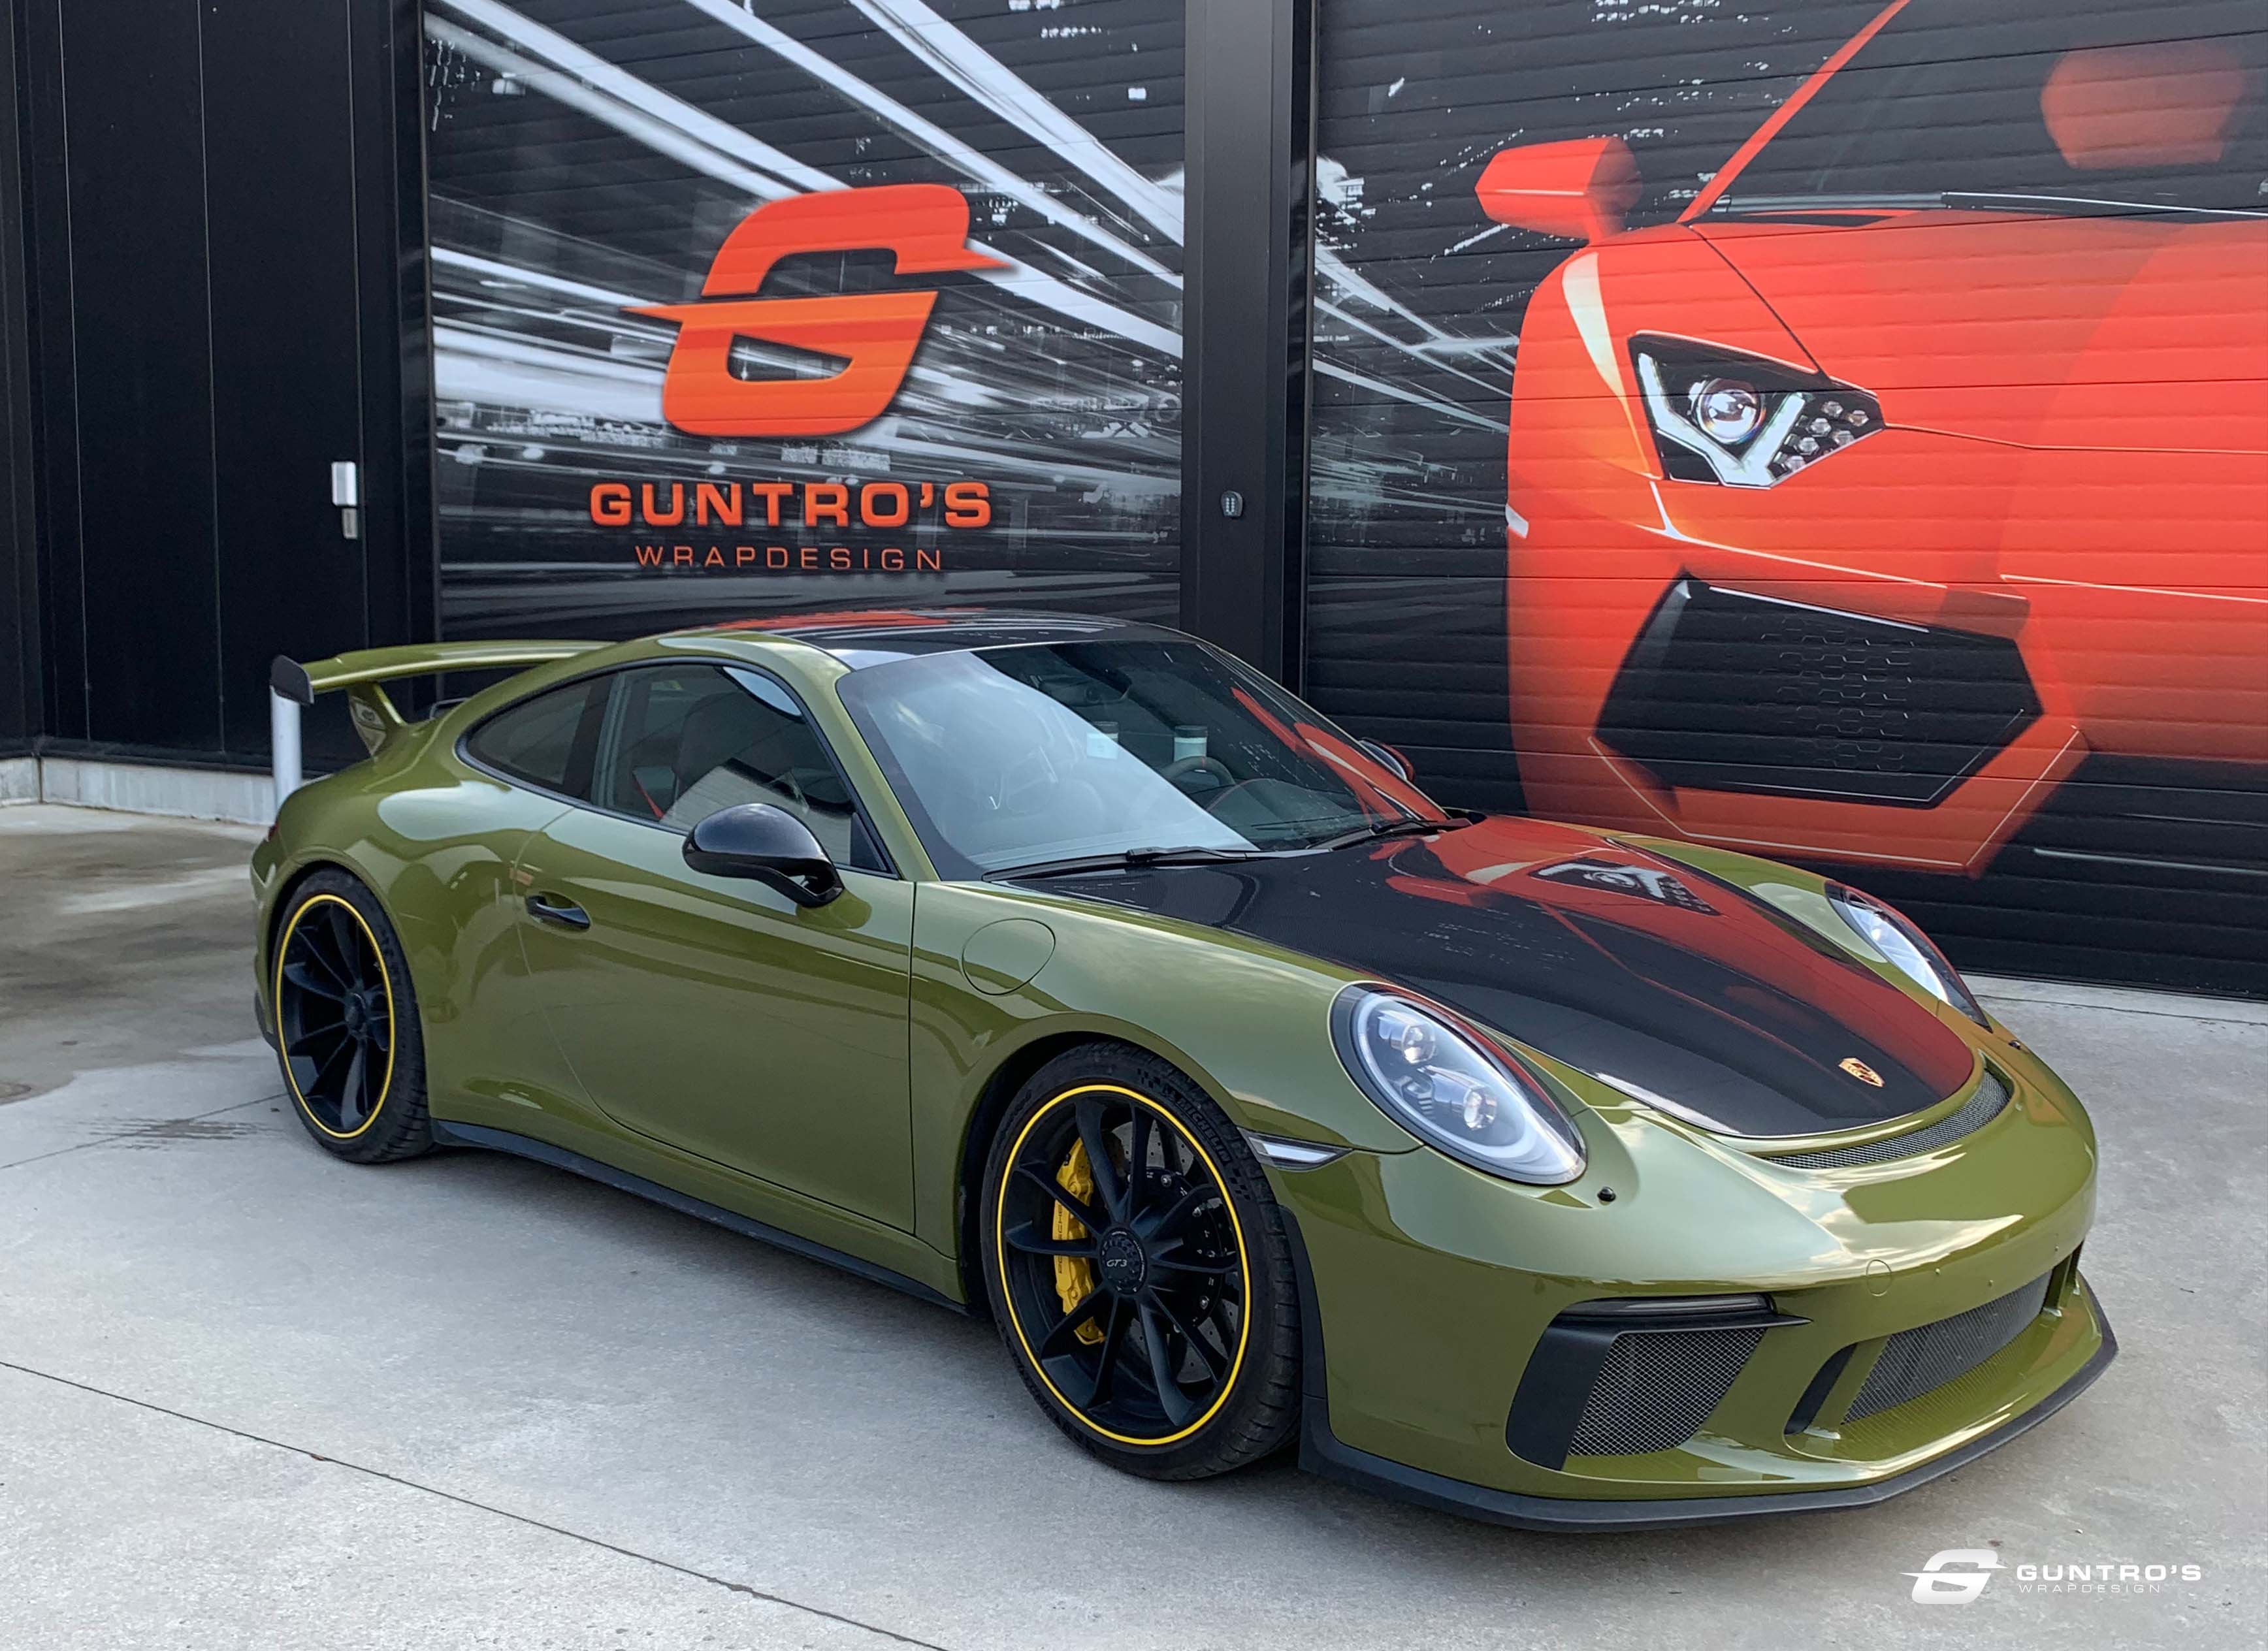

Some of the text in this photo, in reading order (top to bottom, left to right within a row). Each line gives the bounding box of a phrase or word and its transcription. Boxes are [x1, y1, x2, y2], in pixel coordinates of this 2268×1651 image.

[591, 482, 991, 527] GUNTRO'S
[635, 546, 941, 571] WRAPDESIGN
[1176, 1097, 1233, 1162] MICHELIN
